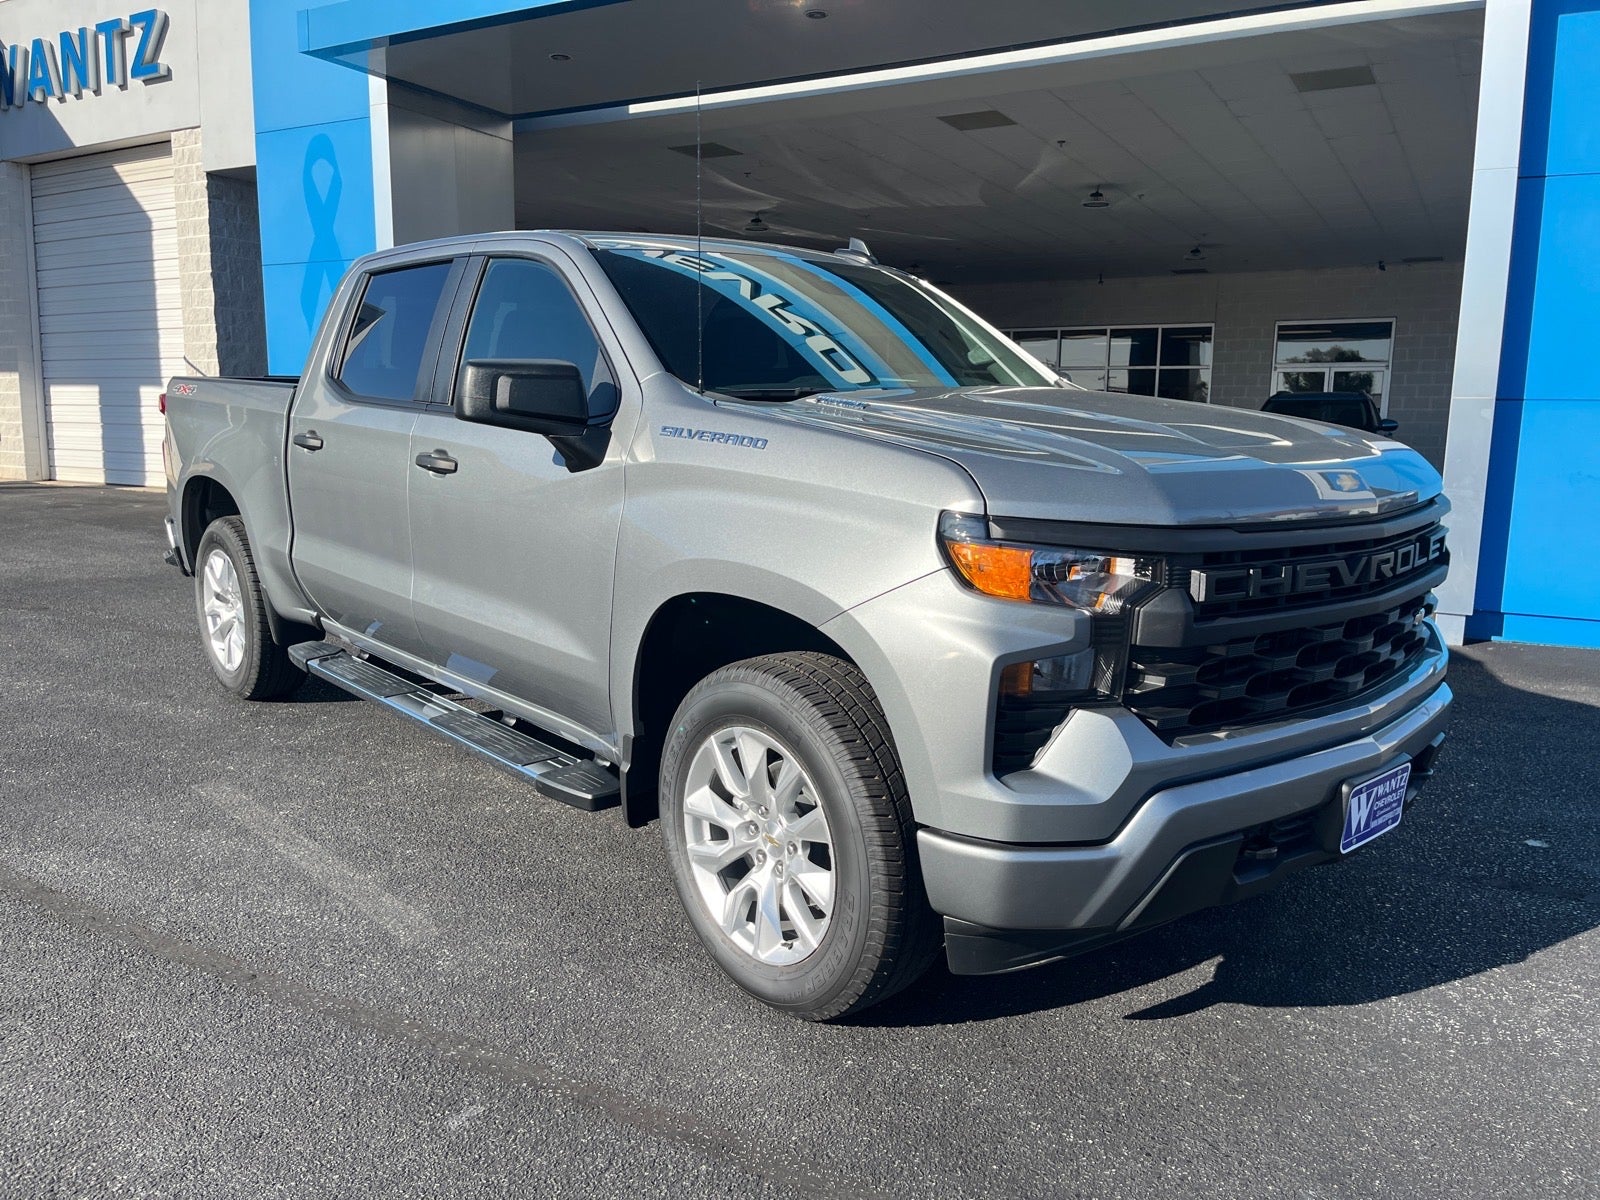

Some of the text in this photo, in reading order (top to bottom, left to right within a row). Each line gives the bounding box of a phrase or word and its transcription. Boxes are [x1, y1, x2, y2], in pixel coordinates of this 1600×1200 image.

[659, 425, 769, 450] SILVERADO
[1378, 774, 1407, 797] WANTZ
[1374, 789, 1405, 810] CHEVROLET
